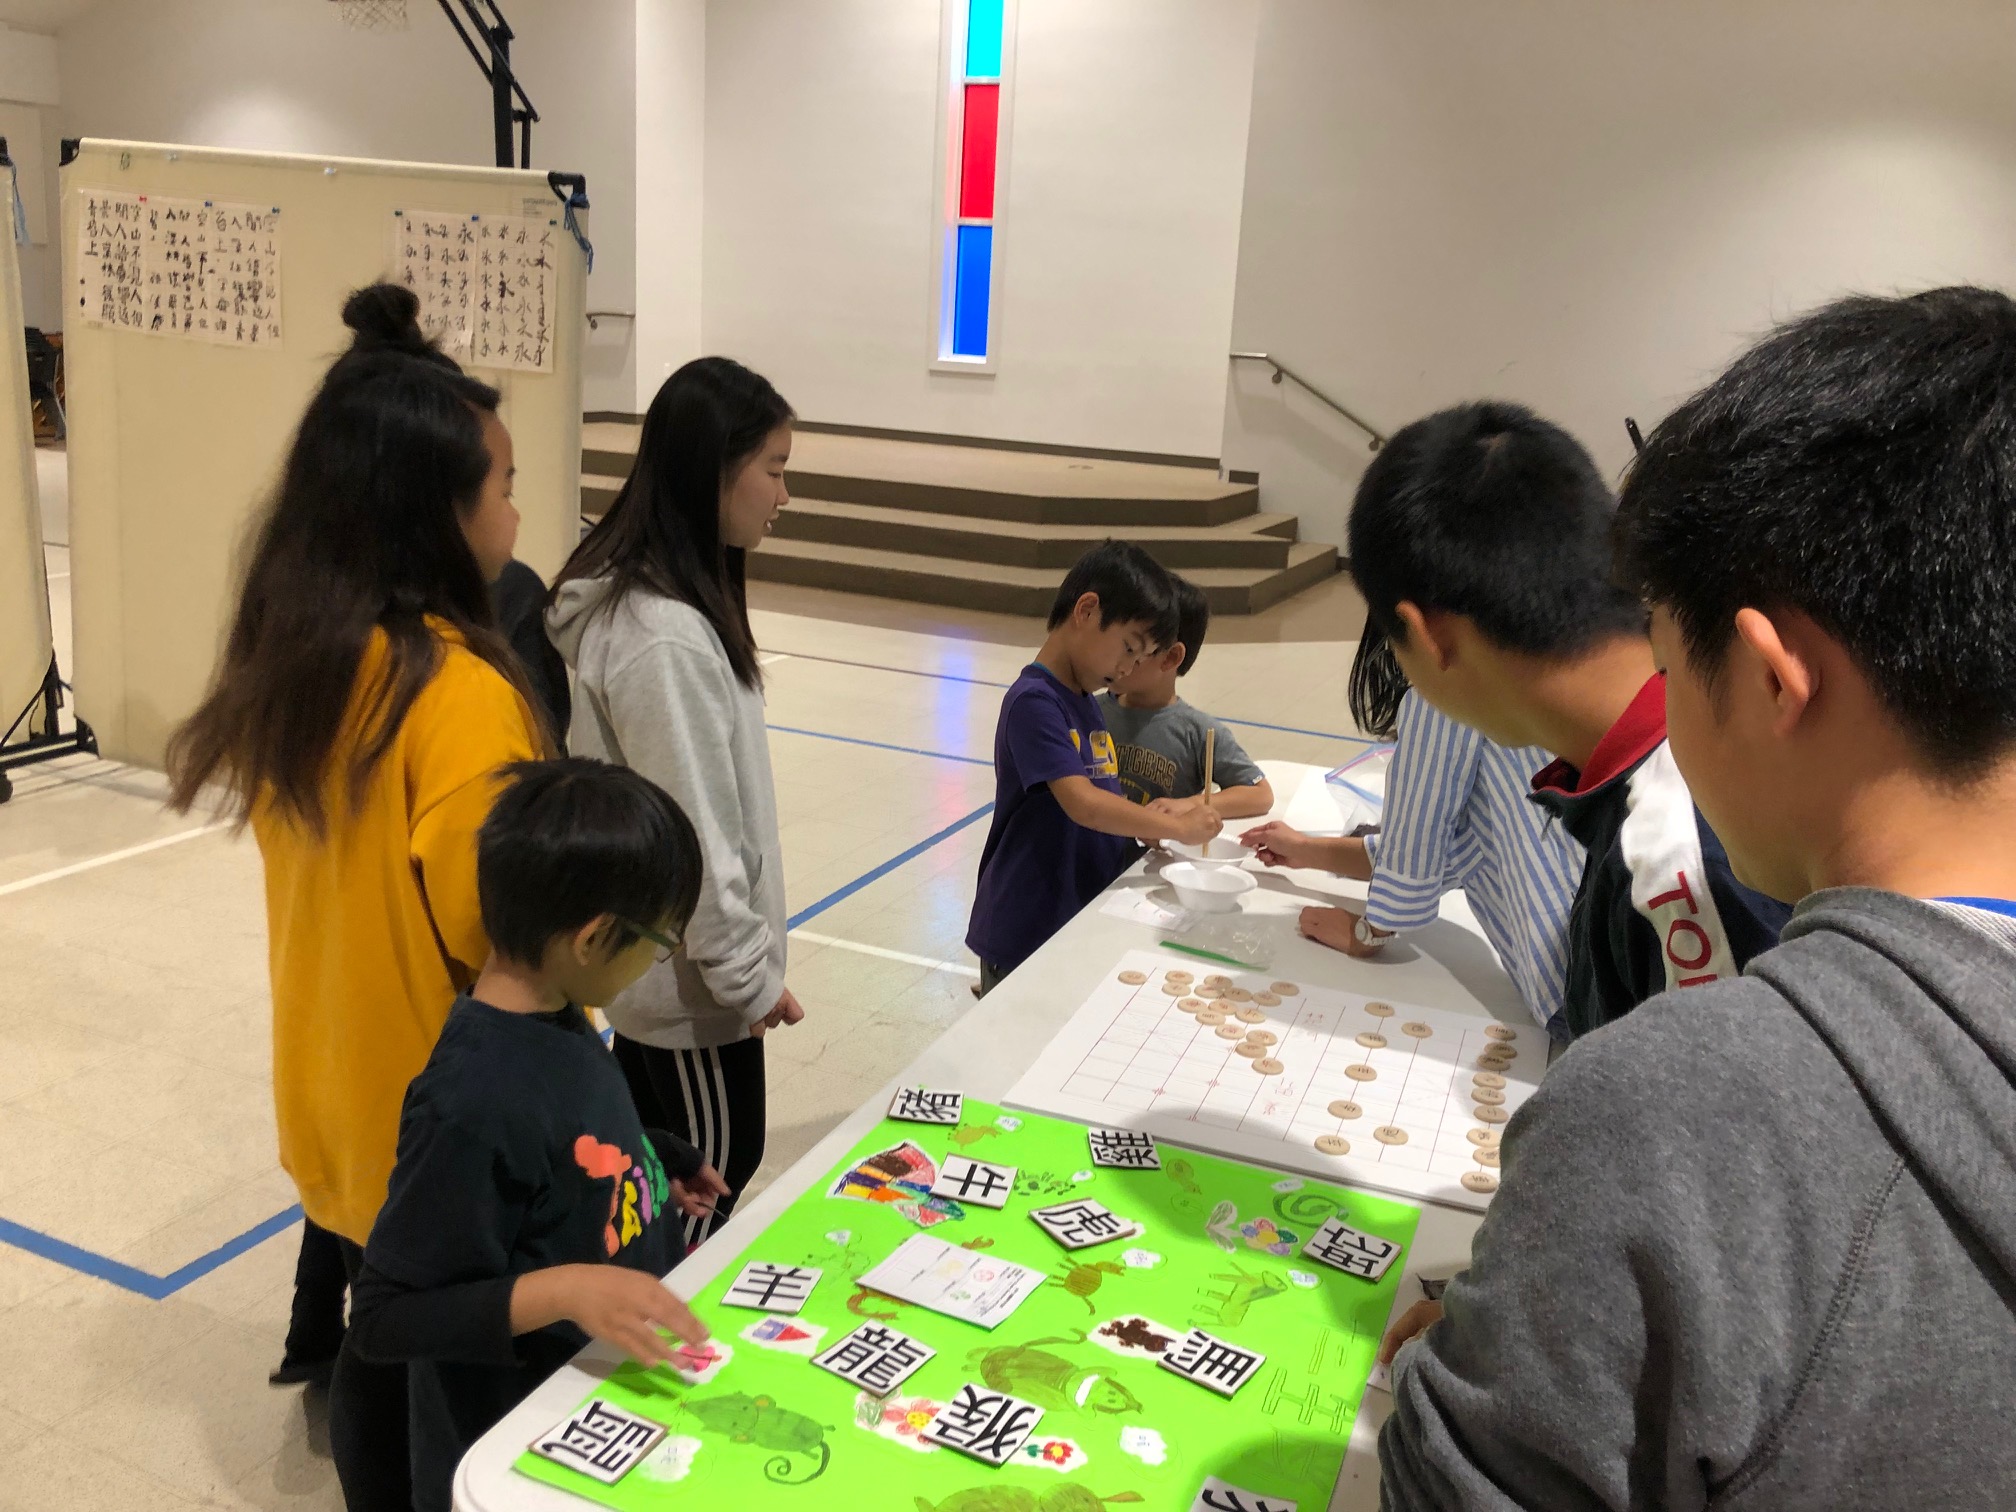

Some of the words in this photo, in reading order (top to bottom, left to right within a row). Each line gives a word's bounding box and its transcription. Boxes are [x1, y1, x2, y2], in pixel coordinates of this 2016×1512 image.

[1116, 744, 1177, 789] TIGERS
[1648, 871, 1718, 990] TO
[942, 1163, 1008, 1198] 牛
[1037, 1204, 1120, 1244] 虎
[1305, 1226, 1393, 1275] 蛇
[733, 1264, 812, 1306] 羊
[824, 1327, 926, 1389] 龍
[1164, 1331, 1257, 1387] 馬
[541, 1401, 655, 1473] 鼠
[936, 1386, 1036, 1459] 猴
